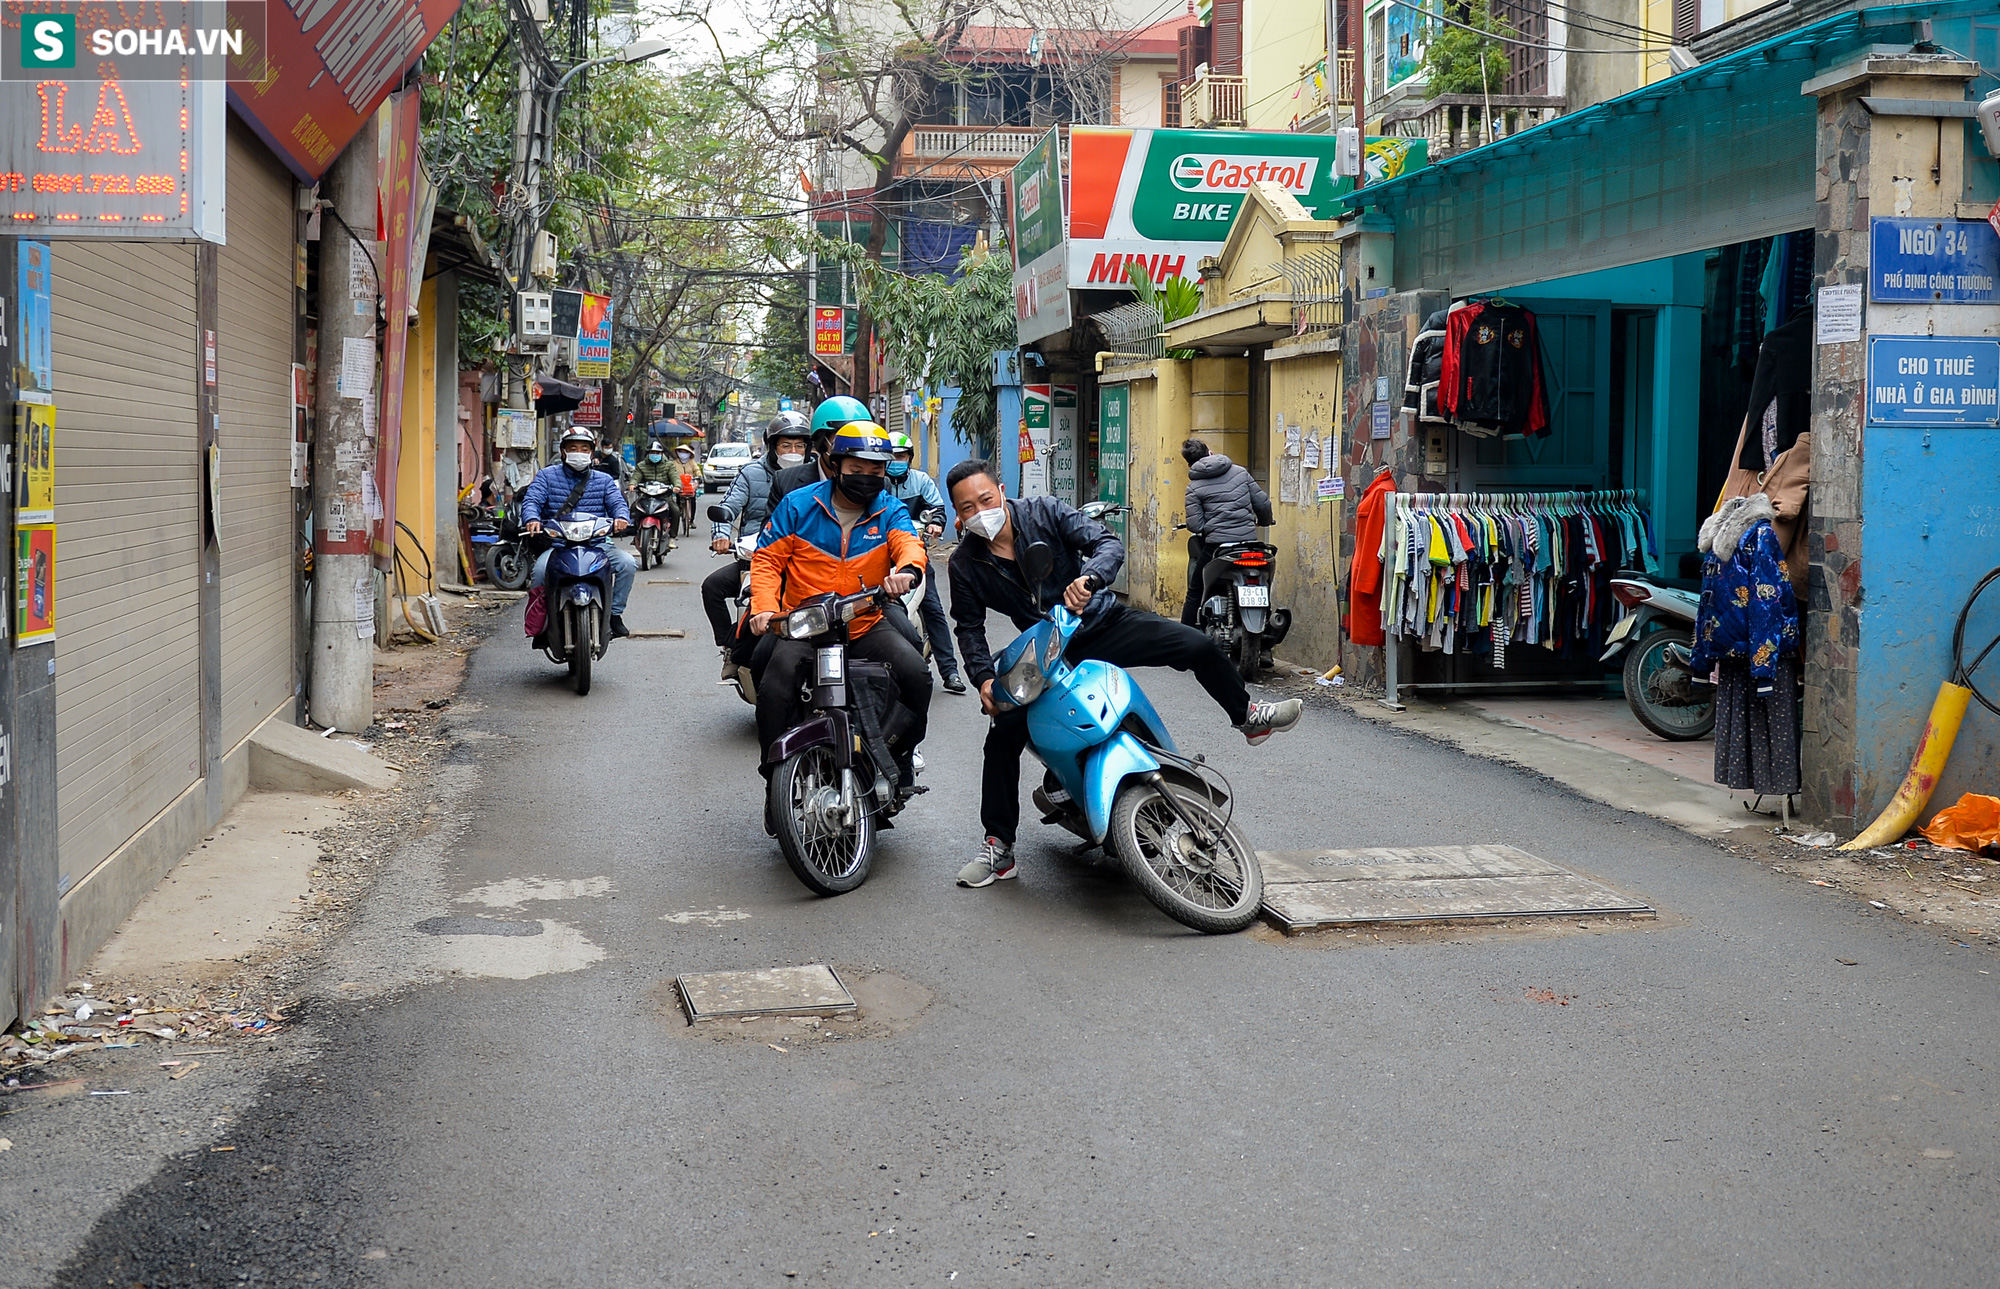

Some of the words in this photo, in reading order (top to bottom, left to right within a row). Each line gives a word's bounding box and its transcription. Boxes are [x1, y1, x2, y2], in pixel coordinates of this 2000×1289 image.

[1206, 158, 1307, 191] Castrol
[1173, 203, 1232, 221] BIKE
[1899, 225, 1936, 256] NGÕ
[1945, 230, 1968, 256] 34
[1087, 253, 1186, 284] MINH
[1884, 269, 1903, 289] PHỐ
[1904, 274, 1927, 293] ĐỊNH
[1929, 272, 1954, 290] CÔNG
[1956, 274, 1993, 293] THƯỢNG
[580, 346, 609, 360] LẠNH
[1898, 357, 1929, 376] CHO
[1934, 356, 1975, 376] THUÊ
[1876, 383, 1907, 404] NHÀ
[1913, 381, 1925, 405] Ở
[1930, 387, 1955, 405] GIA
[1961, 384, 1996, 406] ĐÌNH
[868, 436, 883, 446] be
[1240, 597, 1267, 606] 838.92
[1242, 588, 1264, 596] 29-C1
